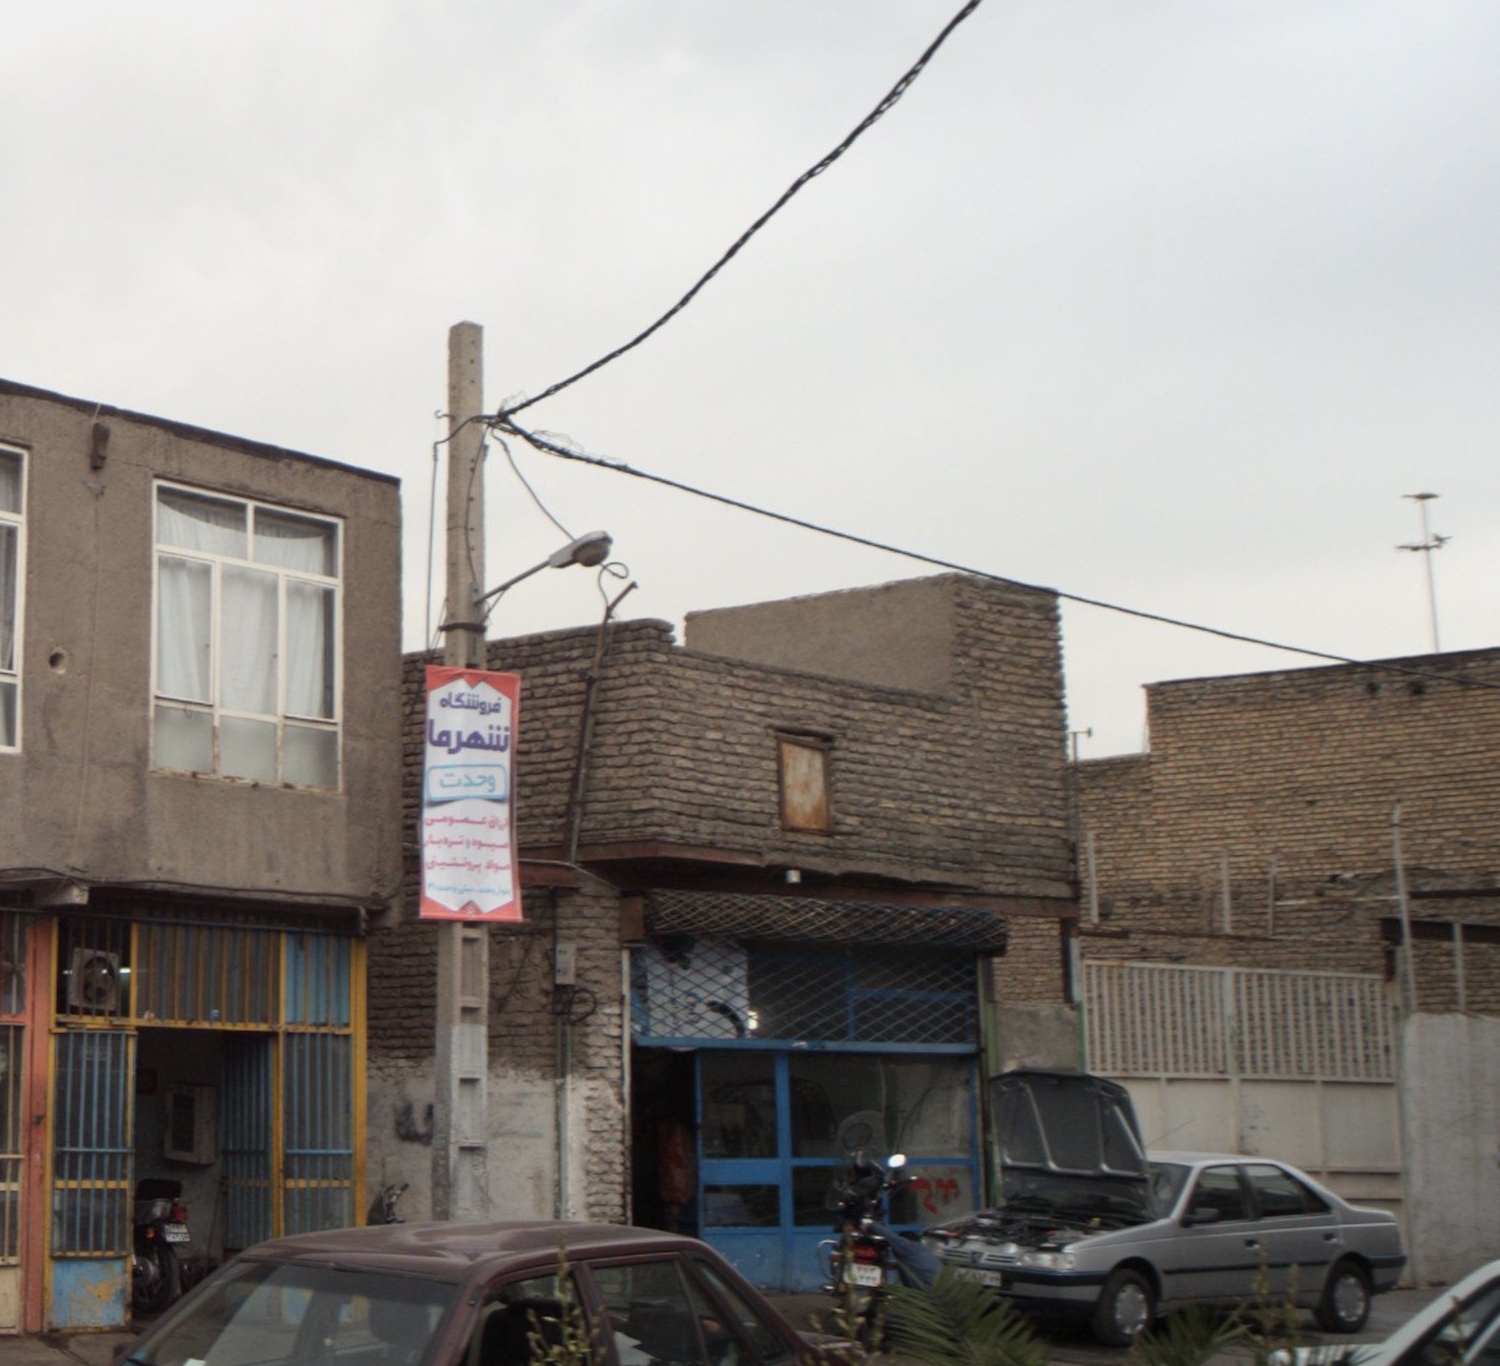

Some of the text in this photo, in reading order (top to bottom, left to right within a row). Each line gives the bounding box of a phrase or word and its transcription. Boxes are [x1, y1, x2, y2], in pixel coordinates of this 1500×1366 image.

[440, 692, 501, 715] فروشگاه
[427, 718, 510, 754] شهر ما
[440, 773, 496, 793] وحدت
